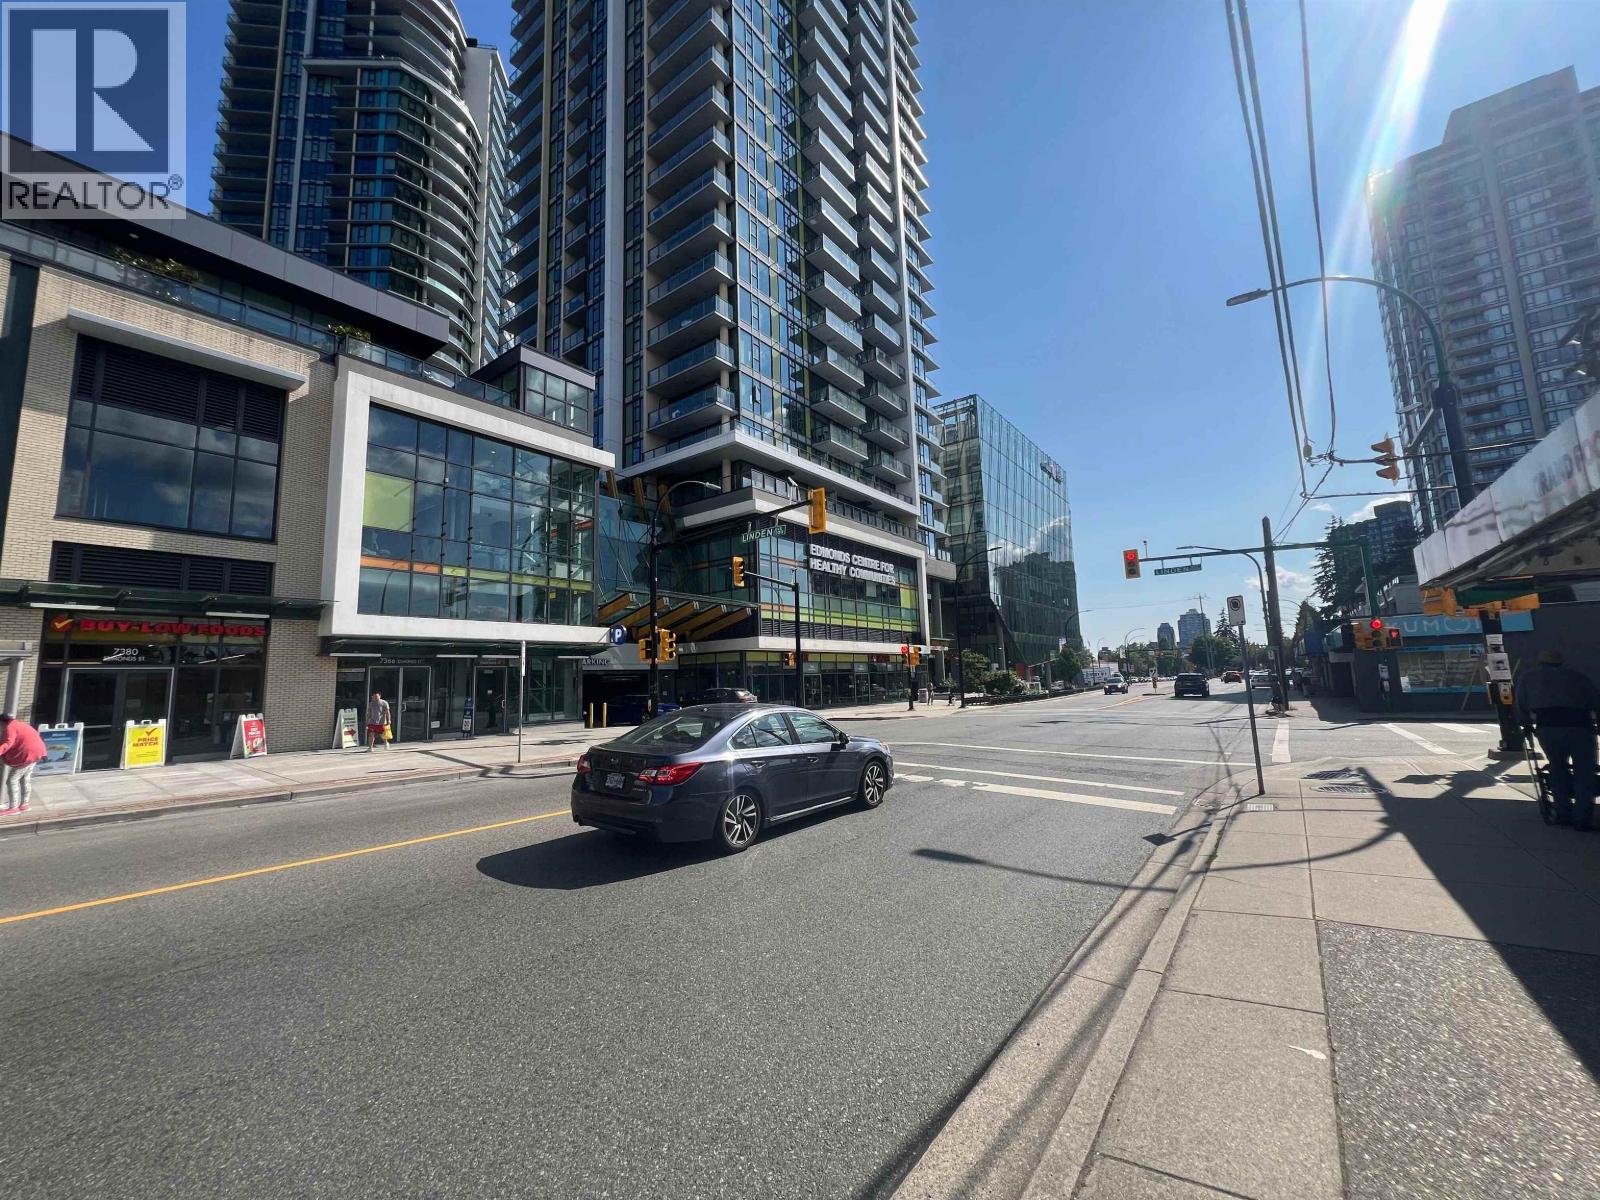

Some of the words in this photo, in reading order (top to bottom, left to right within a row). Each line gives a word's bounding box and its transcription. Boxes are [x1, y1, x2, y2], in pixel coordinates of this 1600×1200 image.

[742, 529, 773, 543] LINDEN
[809, 543, 850, 564] EDMONDS
[851, 554, 880, 571] CENTRE
[879, 561, 895, 574] FOR
[809, 558, 848, 576] HEALTHY
[849, 566, 896, 586] COMMUNITIES
[1155, 566, 1190, 575] LINDEN
[79, 619, 192, 635] BUY-LOW
[196, 623, 265, 636] FOODS
[615, 628, 623, 642] P
[113, 648, 139, 656] 7380
